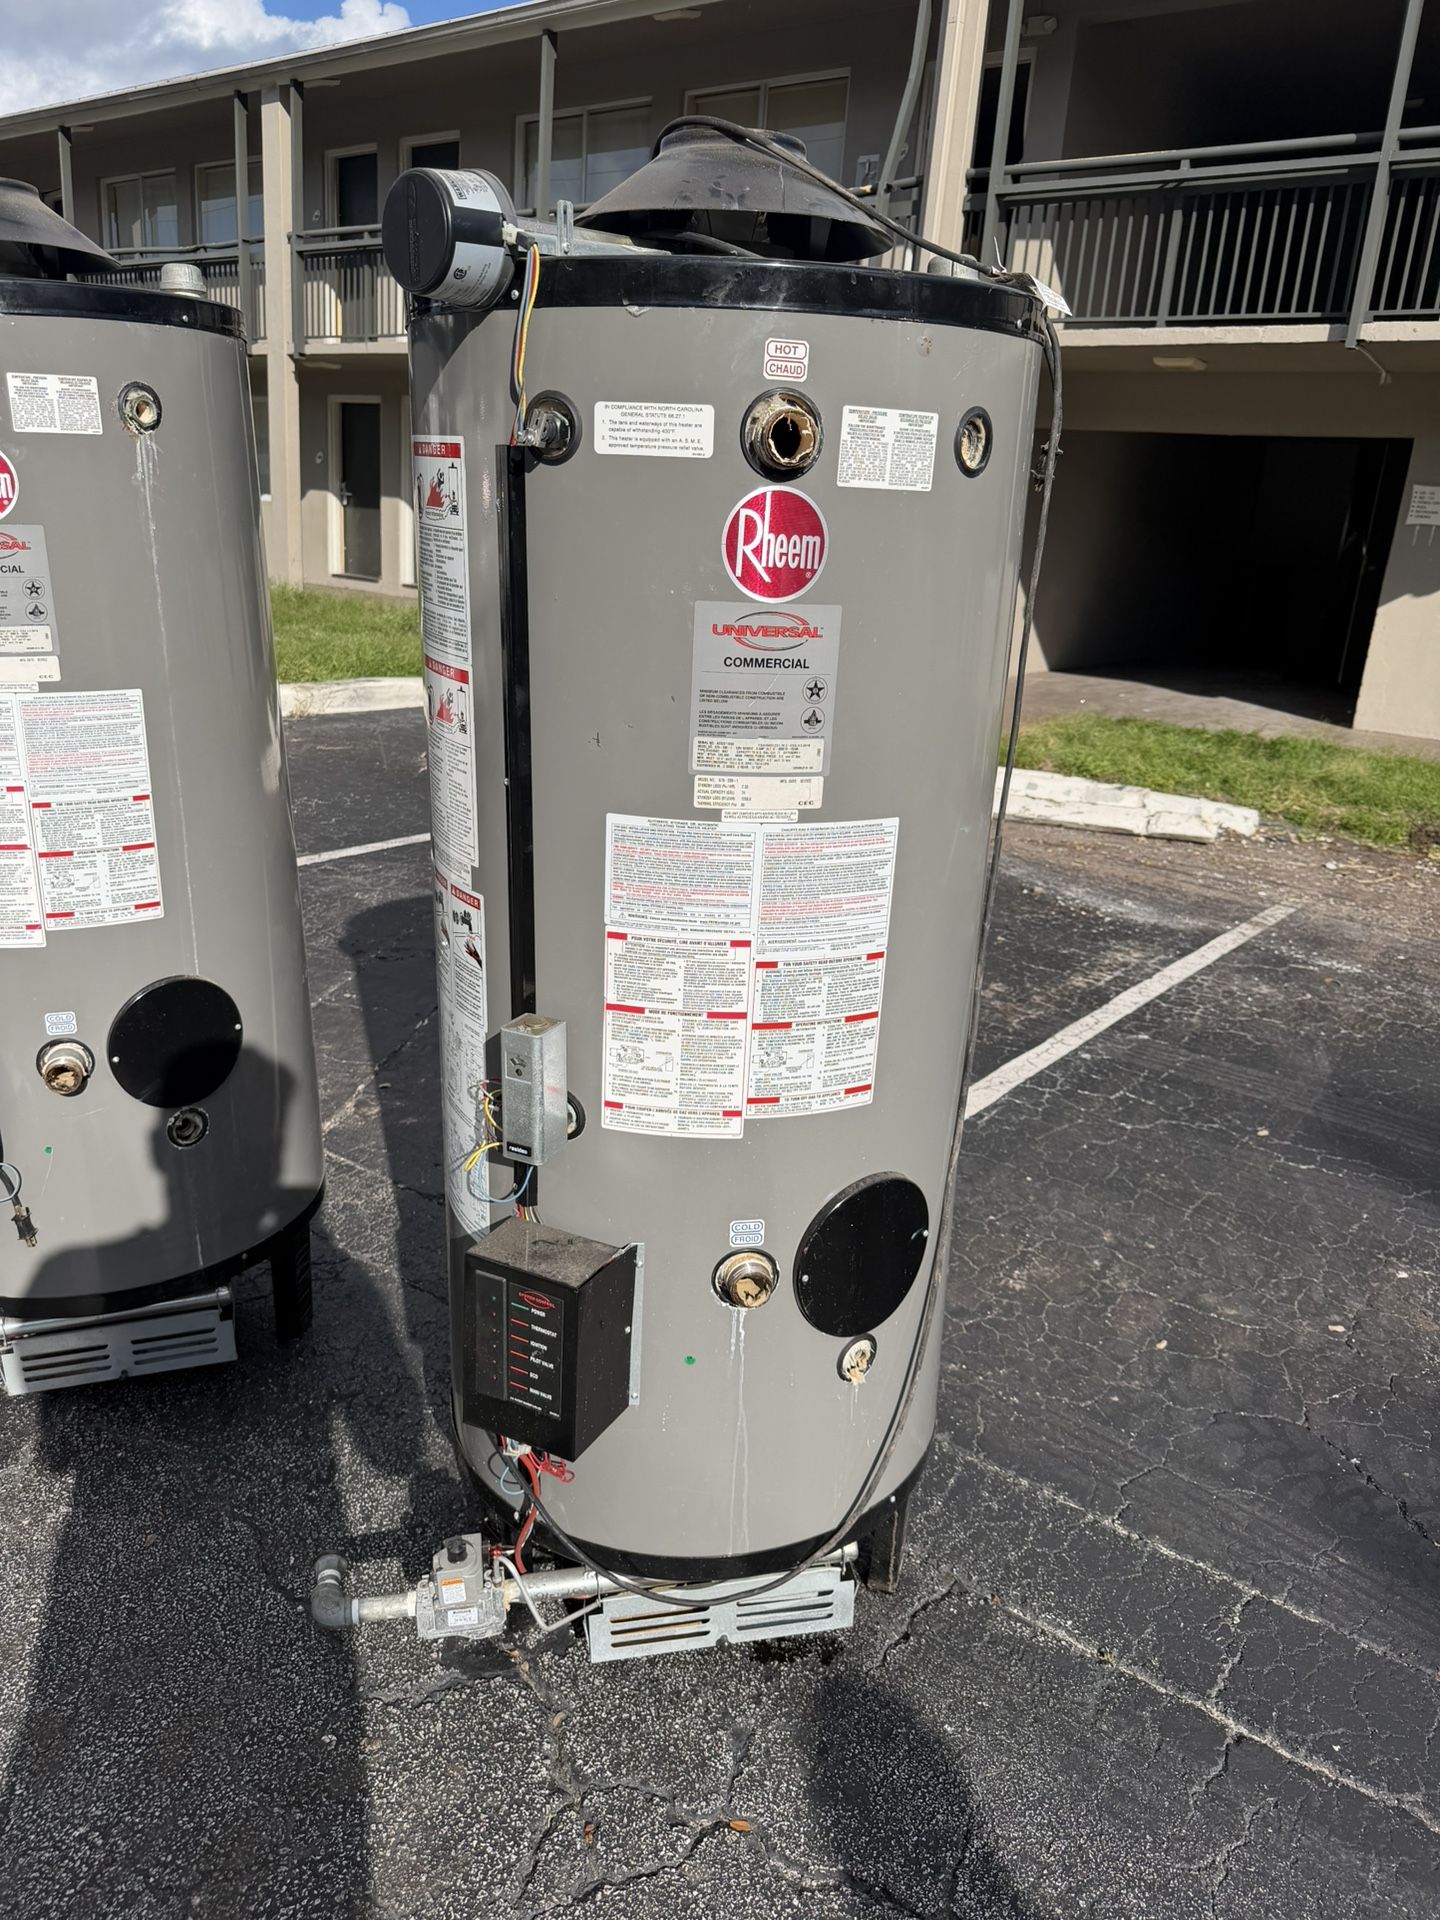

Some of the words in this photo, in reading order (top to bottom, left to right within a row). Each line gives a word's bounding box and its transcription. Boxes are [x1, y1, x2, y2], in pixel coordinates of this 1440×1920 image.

[775, 344, 799, 355] HOT
[770, 363, 803, 375] CHAUD
[423, 443, 446, 455] DANGER
[736, 491, 821, 583] Rheem
[712, 623, 823, 638] UNIVERSAL
[724, 656, 810, 669] COMMERCIAL
[531, 1308, 545, 1317] POWER
[531, 1324, 557, 1338] THERMOSTAT
[530, 1340, 547, 1351] IGNITION
[530, 1356, 541, 1364] PILOT
[542, 1360, 554, 1369] VALVE
[541, 1392, 552, 1400] VALVE
